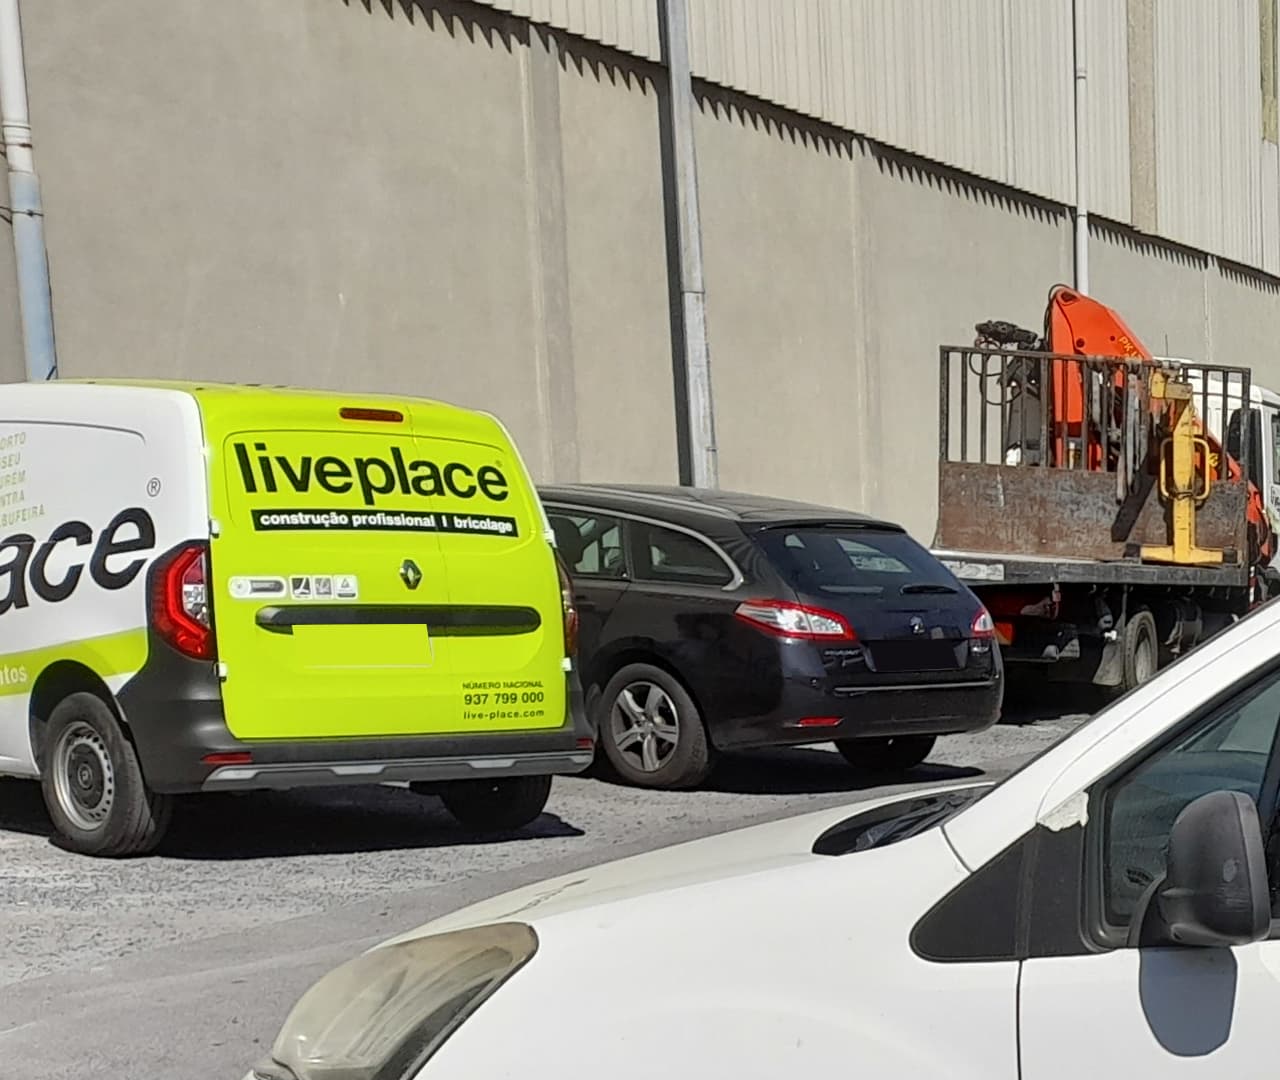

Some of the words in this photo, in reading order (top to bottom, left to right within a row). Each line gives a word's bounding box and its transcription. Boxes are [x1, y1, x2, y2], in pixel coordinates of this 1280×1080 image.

[233, 442, 510, 506] liveplace
[259, 511, 349, 528] construção
[352, 511, 436, 528] profissional
[453, 515, 513, 534] bricolage
[464, 693, 489, 705] 937
[494, 692, 518, 704] 799
[521, 691, 545, 704] 000
[463, 709, 545, 720] live-place.com
